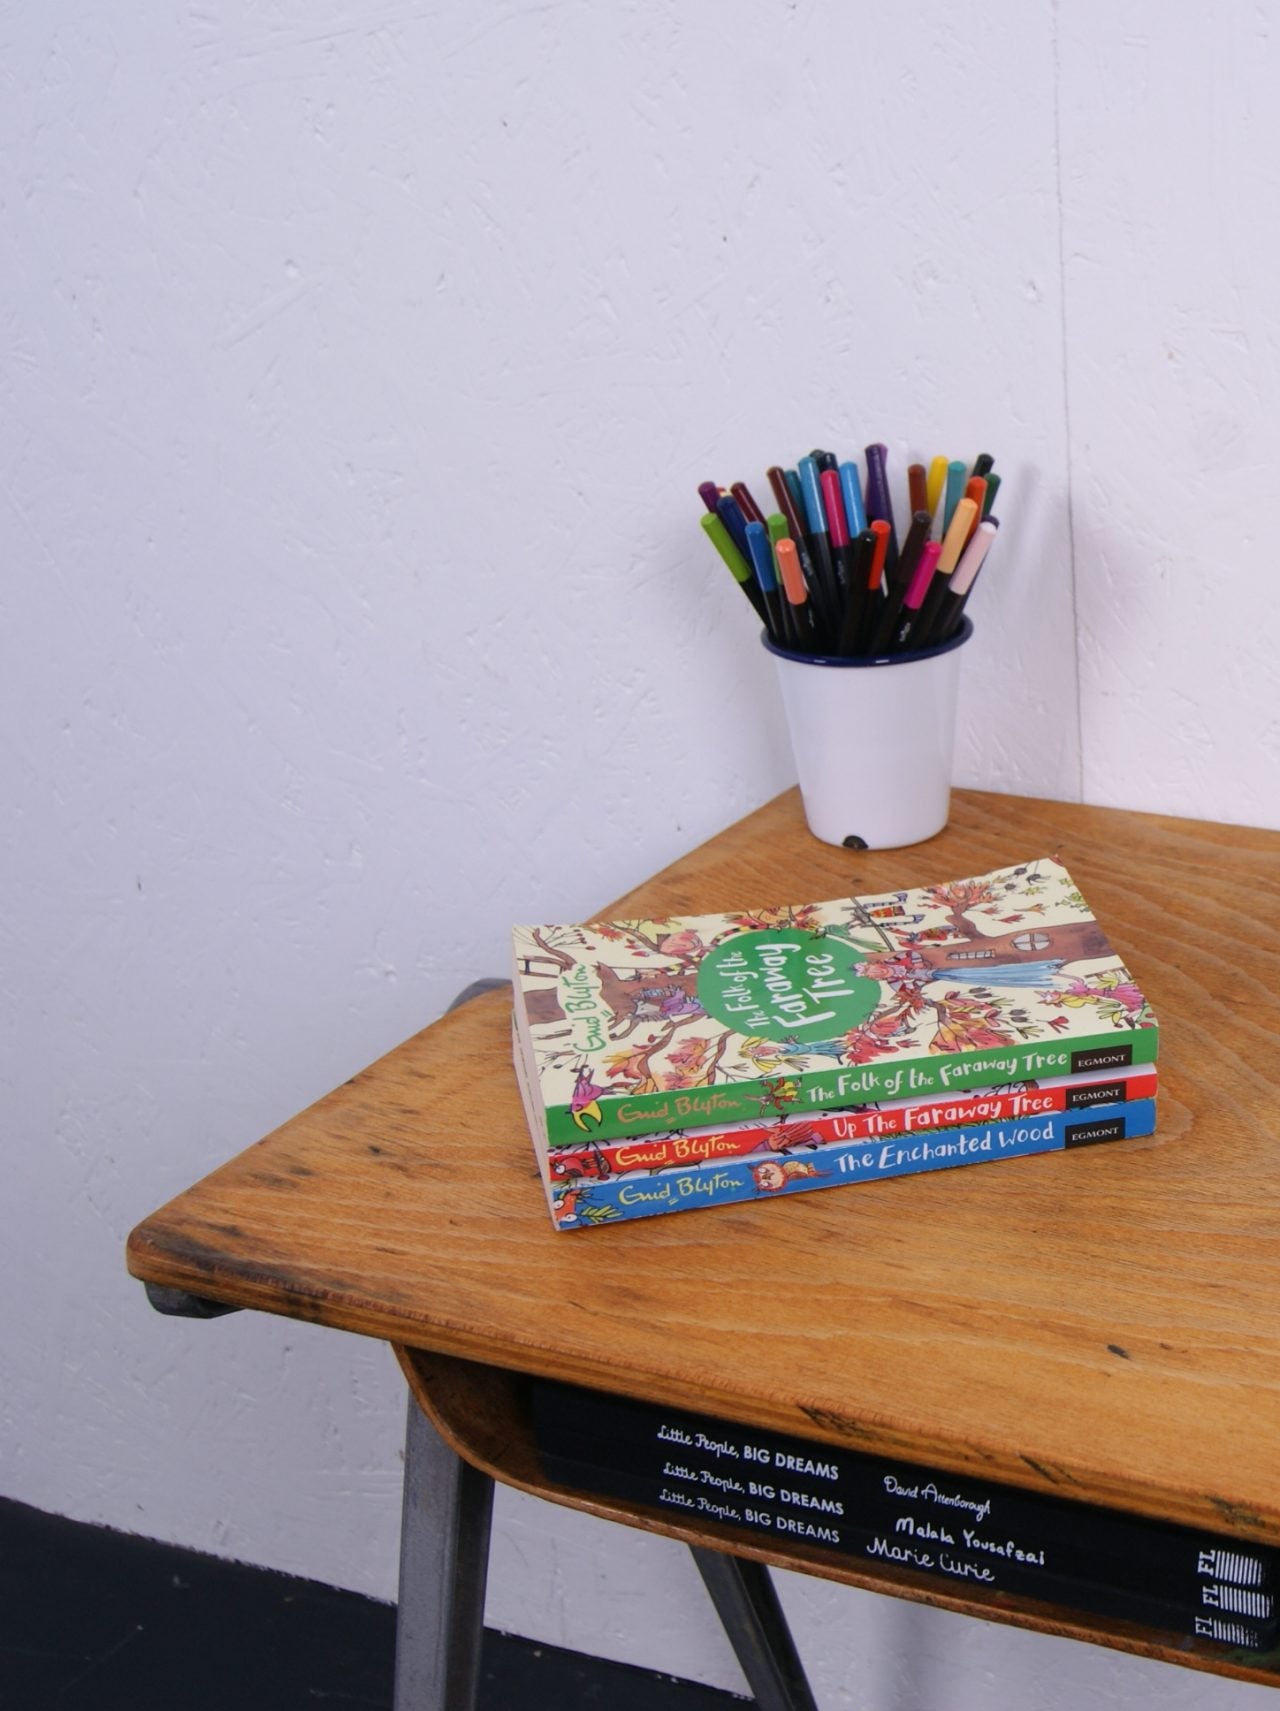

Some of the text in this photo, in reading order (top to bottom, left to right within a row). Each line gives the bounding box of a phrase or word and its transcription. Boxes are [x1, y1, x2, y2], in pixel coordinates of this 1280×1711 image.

[716, 951, 770, 1029] The Folk of the
[754, 943, 836, 1028] Faraway
[802, 953, 855, 1004] Tree
[562, 964, 607, 1052] Enid Blyton
[806, 1052, 1068, 1103] The Folk of the Faraway Tree
[1077, 1054, 1126, 1068] EGMONT
[616, 1093, 742, 1124] Enid Blyton
[833, 1094, 1053, 1138] Up The Faraway Tree
[1072, 1088, 1121, 1102] EGMONT
[615, 1137, 741, 1166] Enid Blyton
[834, 1121, 1055, 1174] The Enchanted Wood
[1071, 1126, 1120, 1141] EGMONT
[618, 1173, 744, 1204] Enid Blyton
[657, 1425, 839, 1480] Little People, BIG DREAMS
[663, 1462, 844, 1515] Little People, BIG DREAMS
[883, 1475, 990, 1521] David Attenborough
[659, 1488, 840, 1543] Little People, BIG DREAMS
[866, 1537, 996, 1582] Marie Curie
[895, 1517, 1044, 1566] Malala Yousafzai
